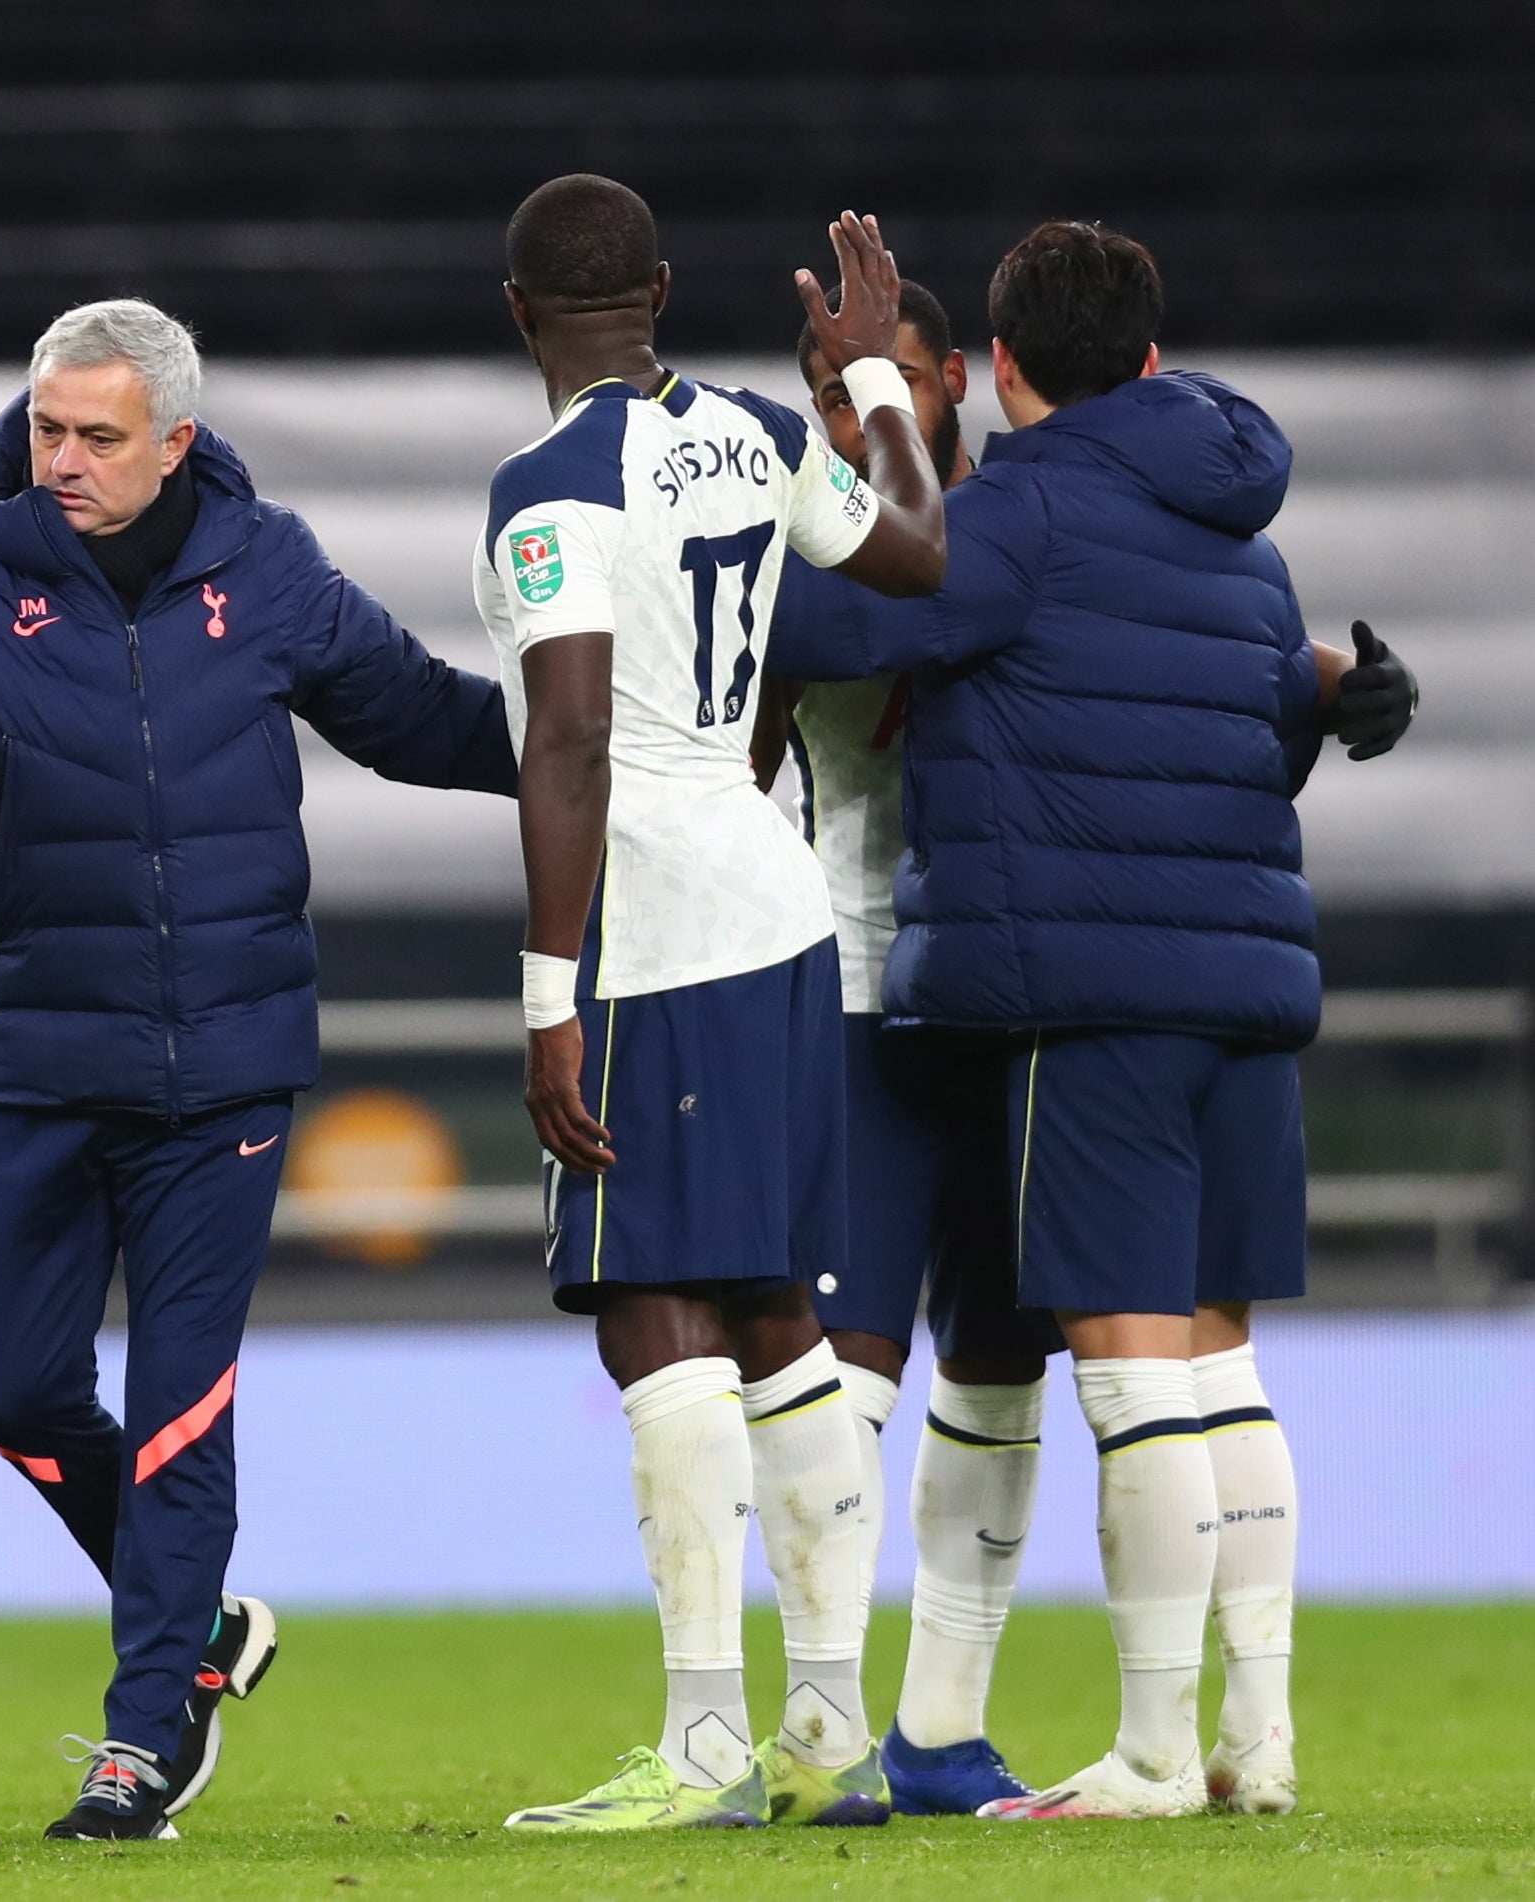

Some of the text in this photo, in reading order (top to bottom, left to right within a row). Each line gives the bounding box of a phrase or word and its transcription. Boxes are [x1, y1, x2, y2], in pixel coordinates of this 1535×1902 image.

[527, 567, 550, 585] Cup
[18, 596, 47, 619] JM
[680, 518, 776, 729] 17
[1223, 1506, 1285, 1523] SPURS
